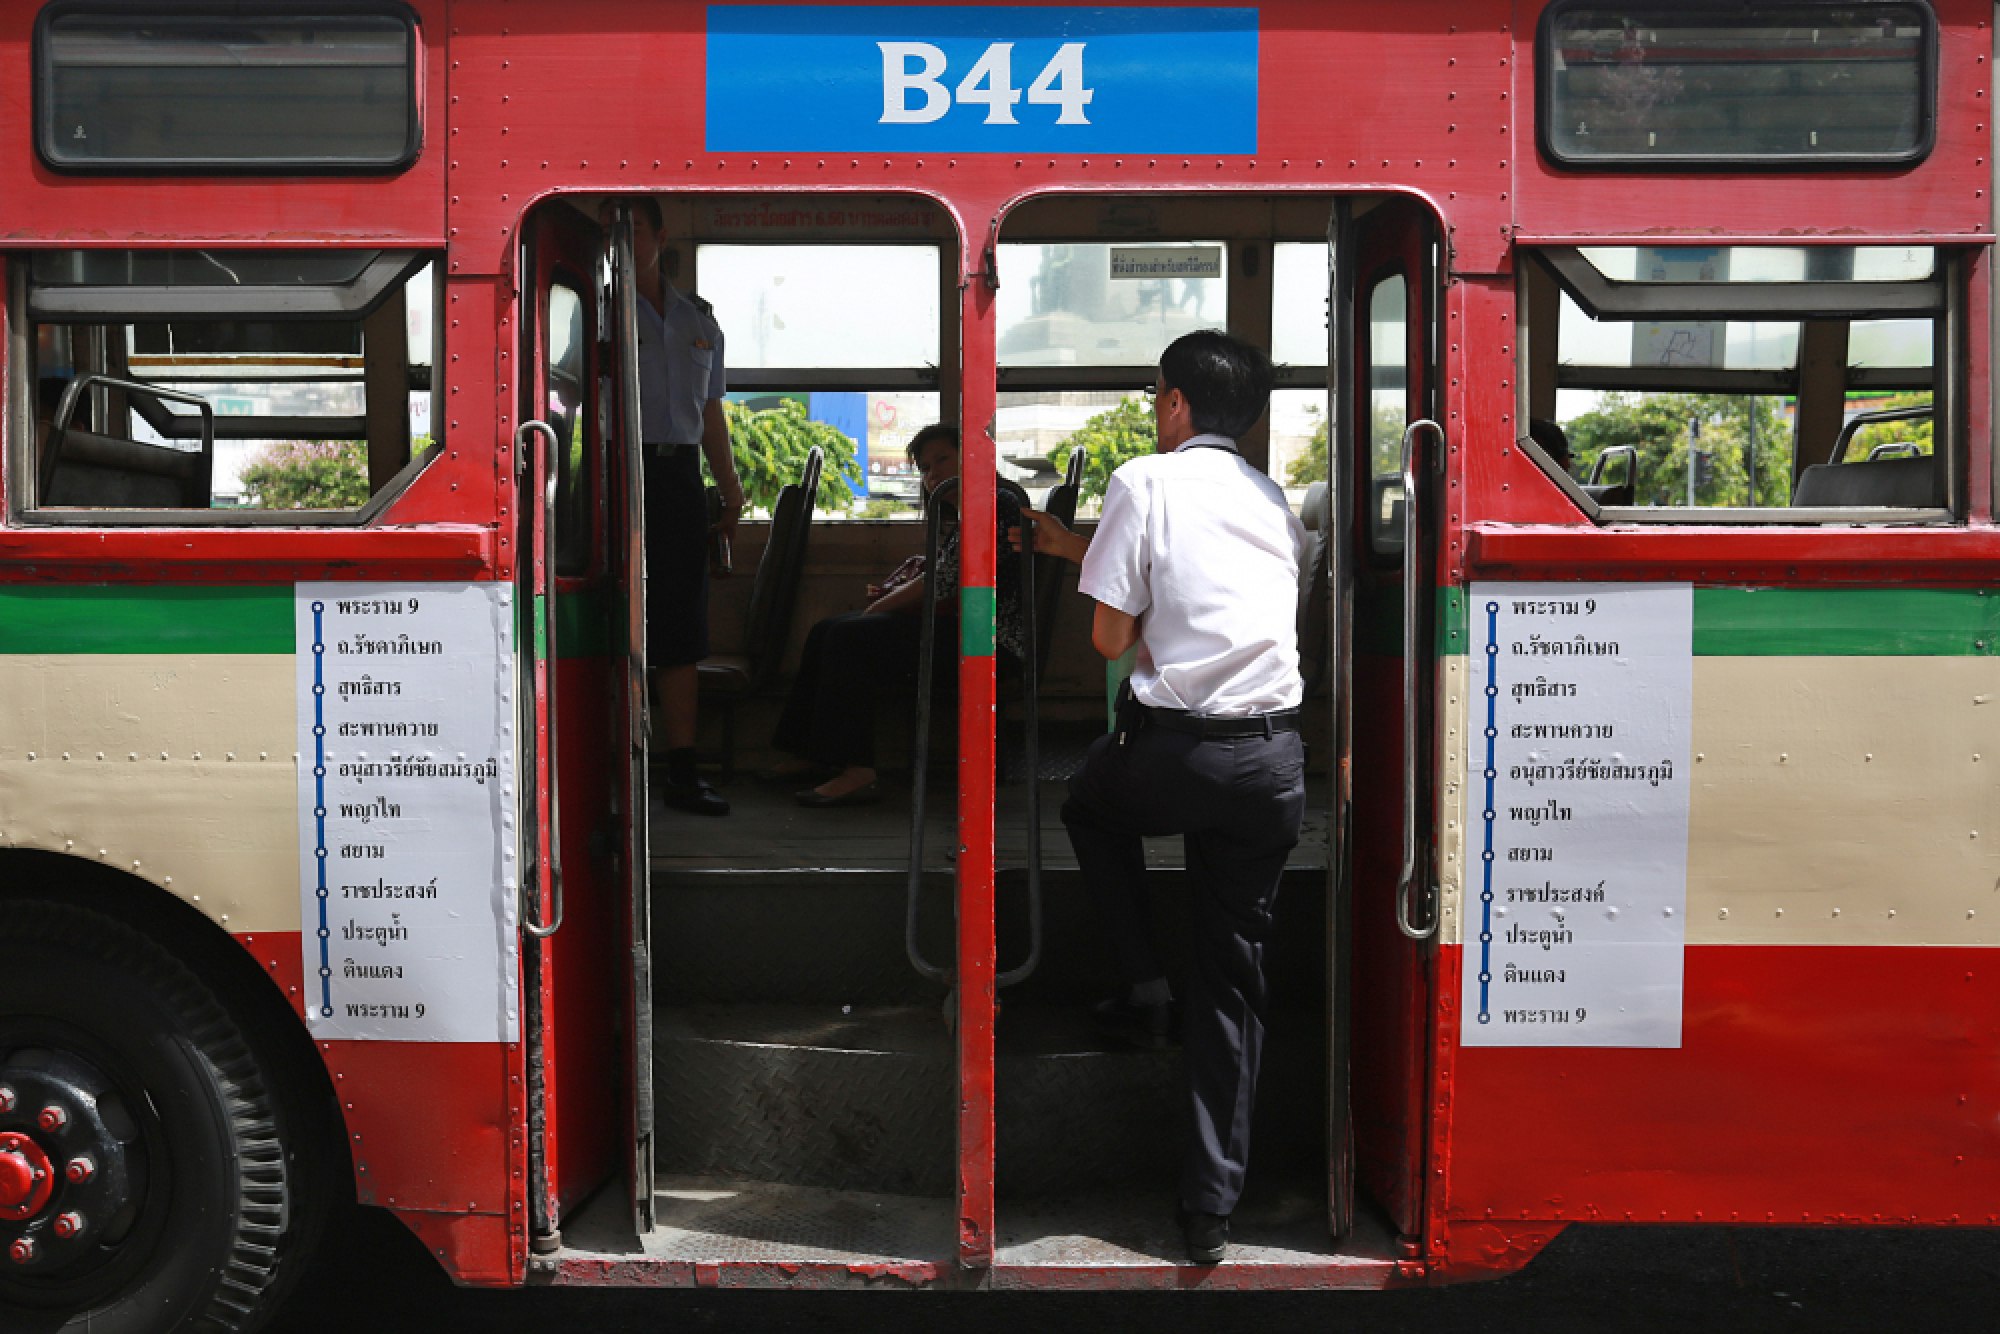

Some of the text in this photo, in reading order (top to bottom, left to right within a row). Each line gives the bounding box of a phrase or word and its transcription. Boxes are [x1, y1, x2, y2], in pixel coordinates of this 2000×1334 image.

[876, 41, 1094, 124] B44
[336, 597, 419, 615] พระราม 9
[1511, 598, 1597, 615] พระราม 9
[337, 634, 443, 655] ถ.รัชดาภิเษก
[1511, 633, 1619, 656] ถ.รัชดาภิเษก
[338, 674, 402, 703] สุทธิสาร
[1511, 675, 1577, 705] สุทธิสาร
[338, 722, 439, 737] สะพานควาย
[1511, 723, 1613, 739] สะพานควาย
[339, 755, 497, 785] อนุสาวรีย์ชัยสมรภูมิ
[1509, 757, 1674, 787] อนุสาวรีย์ชัยสมรภูมิ
[339, 796, 401, 824] พญาไท
[1508, 799, 1572, 827] พญาไท
[340, 843, 385, 859] สยาม
[1507, 847, 1553, 862] สยาม
[341, 877, 438, 899] ราชประสงค์
[1506, 879, 1606, 903] ราชประสงค์
[342, 912, 408, 947] ประตูน้ำ
[1505, 914, 1573, 951] ประตูน้ำ
[343, 957, 403, 979] ดินแดง
[1503, 961, 1566, 983] ดินแดง
[345, 1002, 426, 1019] พระราม 9
[1503, 1007, 1587, 1024] พระราม 9
